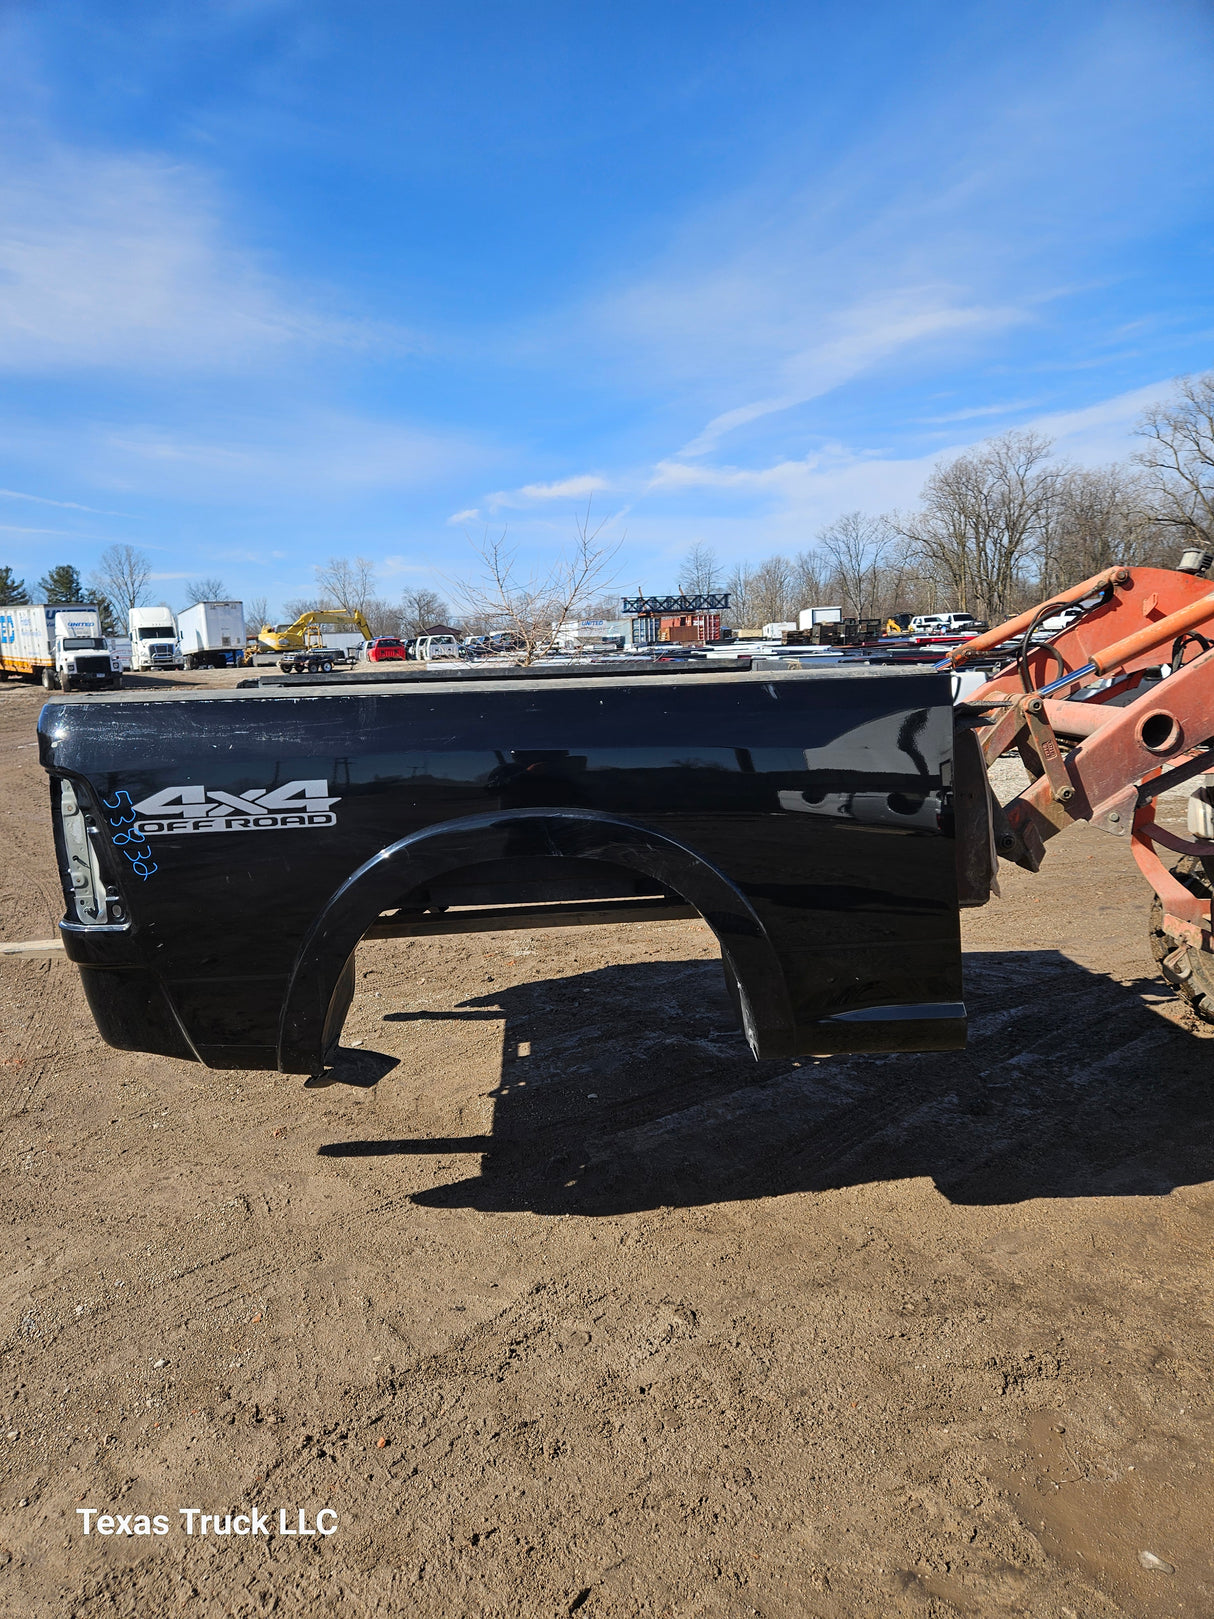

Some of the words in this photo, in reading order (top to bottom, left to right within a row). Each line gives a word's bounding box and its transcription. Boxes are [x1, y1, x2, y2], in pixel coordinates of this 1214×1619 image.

[103, 790, 158, 881] 53832
[138, 819, 215, 833] OFF
[225, 814, 332, 830] ROAD
